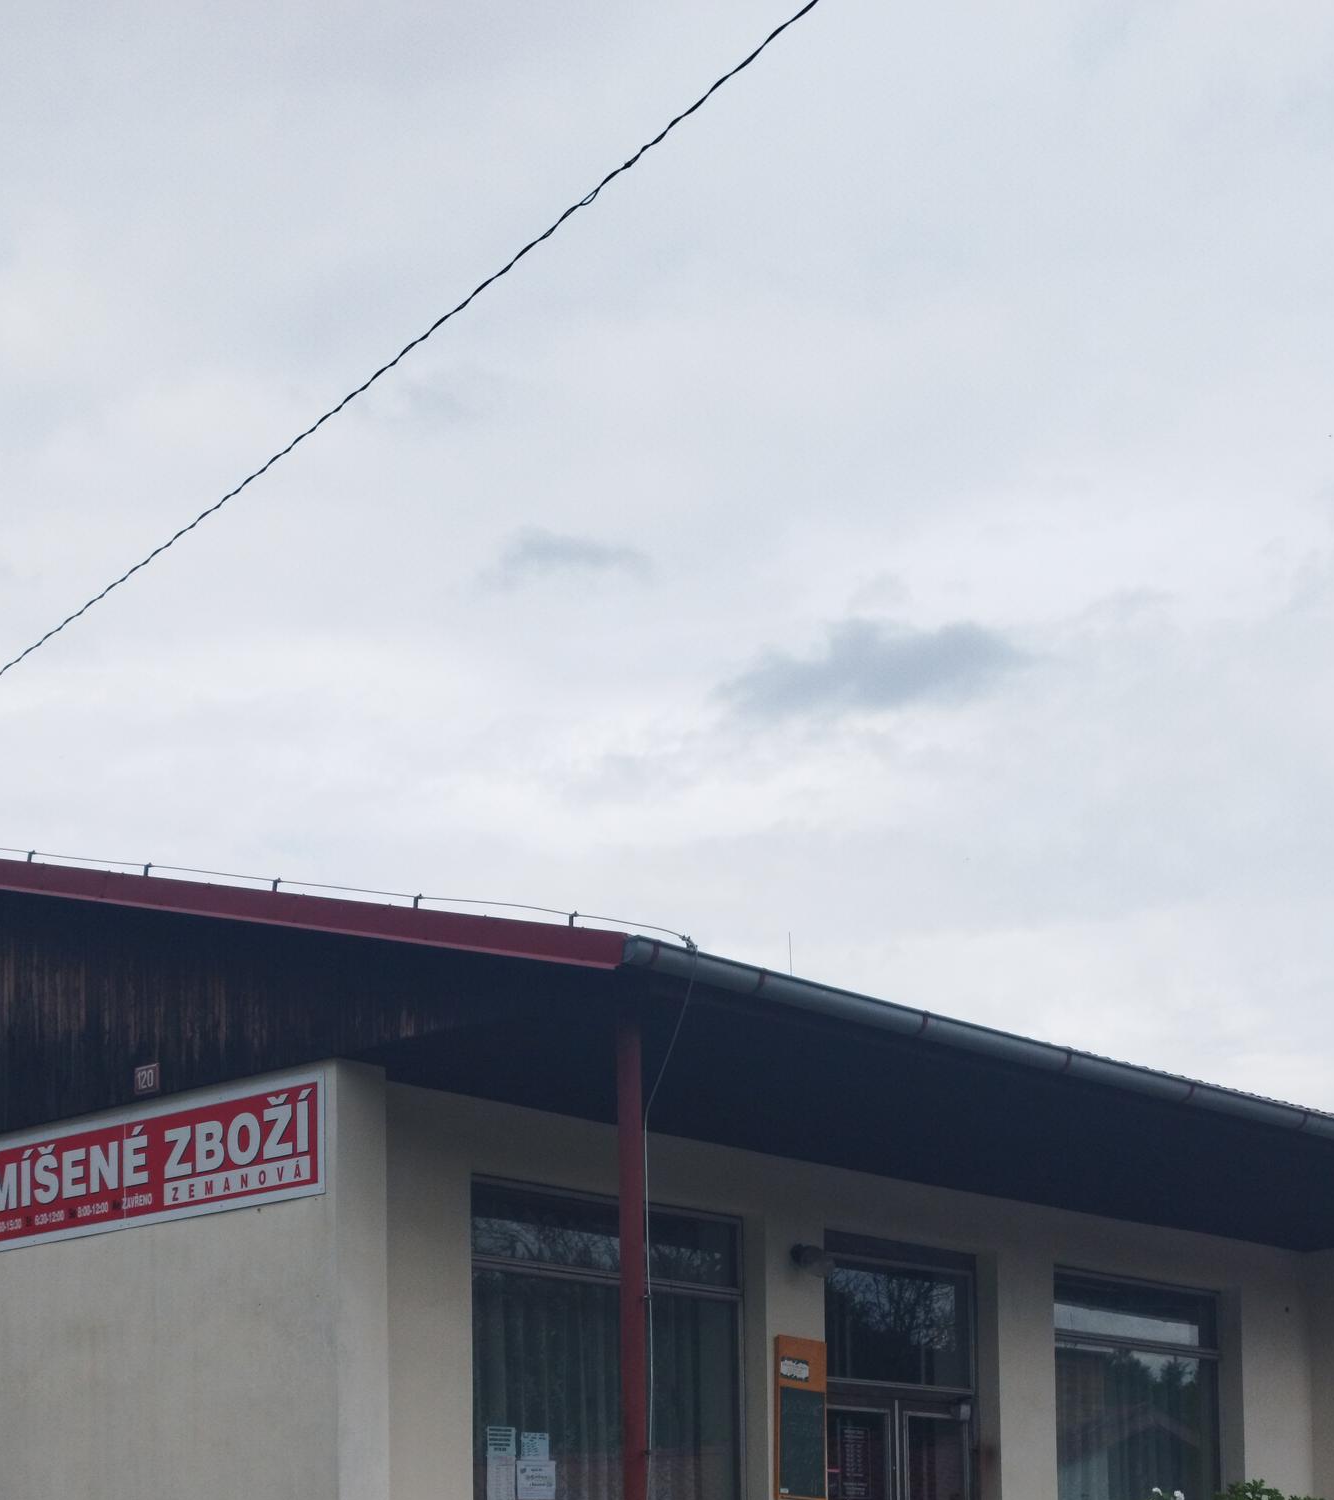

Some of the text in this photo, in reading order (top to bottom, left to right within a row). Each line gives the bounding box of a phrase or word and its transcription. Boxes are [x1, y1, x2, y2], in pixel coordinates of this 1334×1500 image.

[136, 1069, 154, 1090] 120
[164, 1088, 313, 1179] ZBOŽÍ
[171, 1160, 302, 1202] ZEMANOVÁ
[122, 1192, 153, 1210] ZAVŘENO
